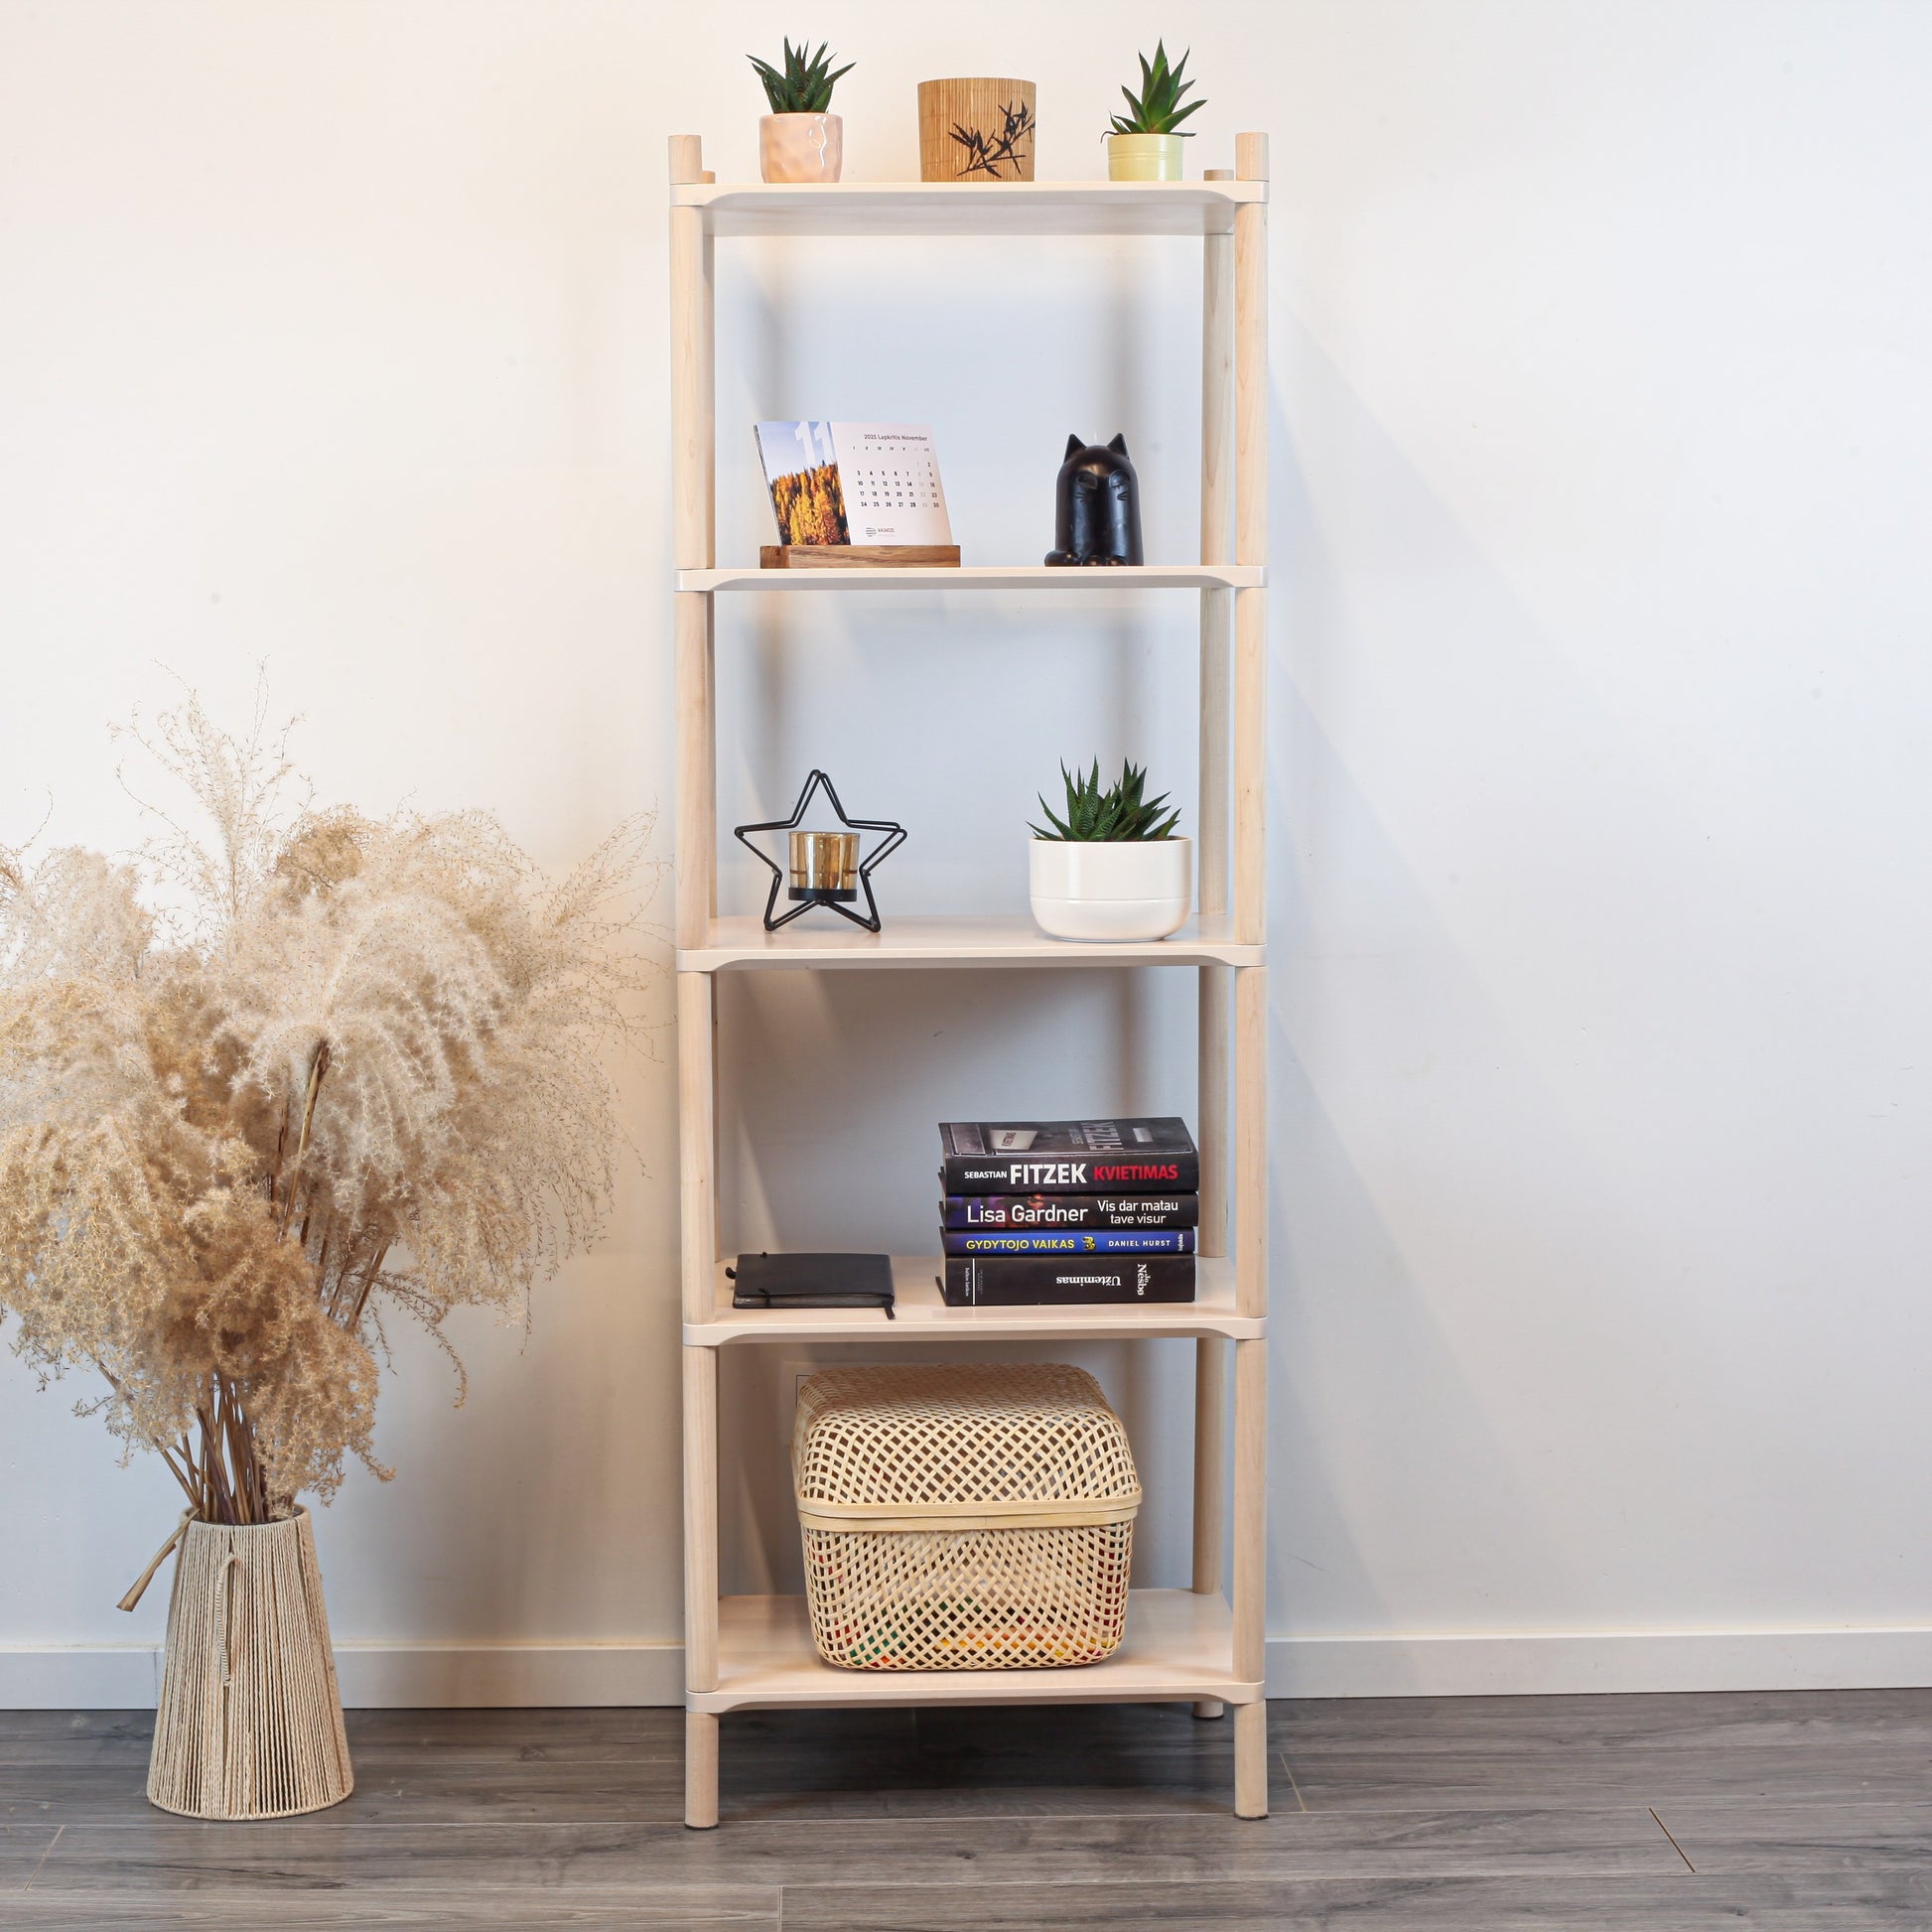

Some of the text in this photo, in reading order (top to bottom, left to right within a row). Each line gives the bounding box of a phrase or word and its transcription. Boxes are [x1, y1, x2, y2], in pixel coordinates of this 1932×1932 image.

[794, 421, 836, 465] 11
[1081, 1121, 1124, 1151] FITZEK
[1010, 1163, 1088, 1184] FITZEK
[1093, 1165, 1179, 1181] KVIETIMAS
[1097, 1200, 1178, 1212] Vis dar matau
[967, 1204, 1089, 1223] Lisa Gardner
[1110, 1213, 1167, 1224] tave visur
[966, 1239, 1075, 1251] GYDYTOJO VAIKAS
[1056, 1276, 1122, 1287] Užtemimas
[1145, 1273, 1151, 1283] Jo
